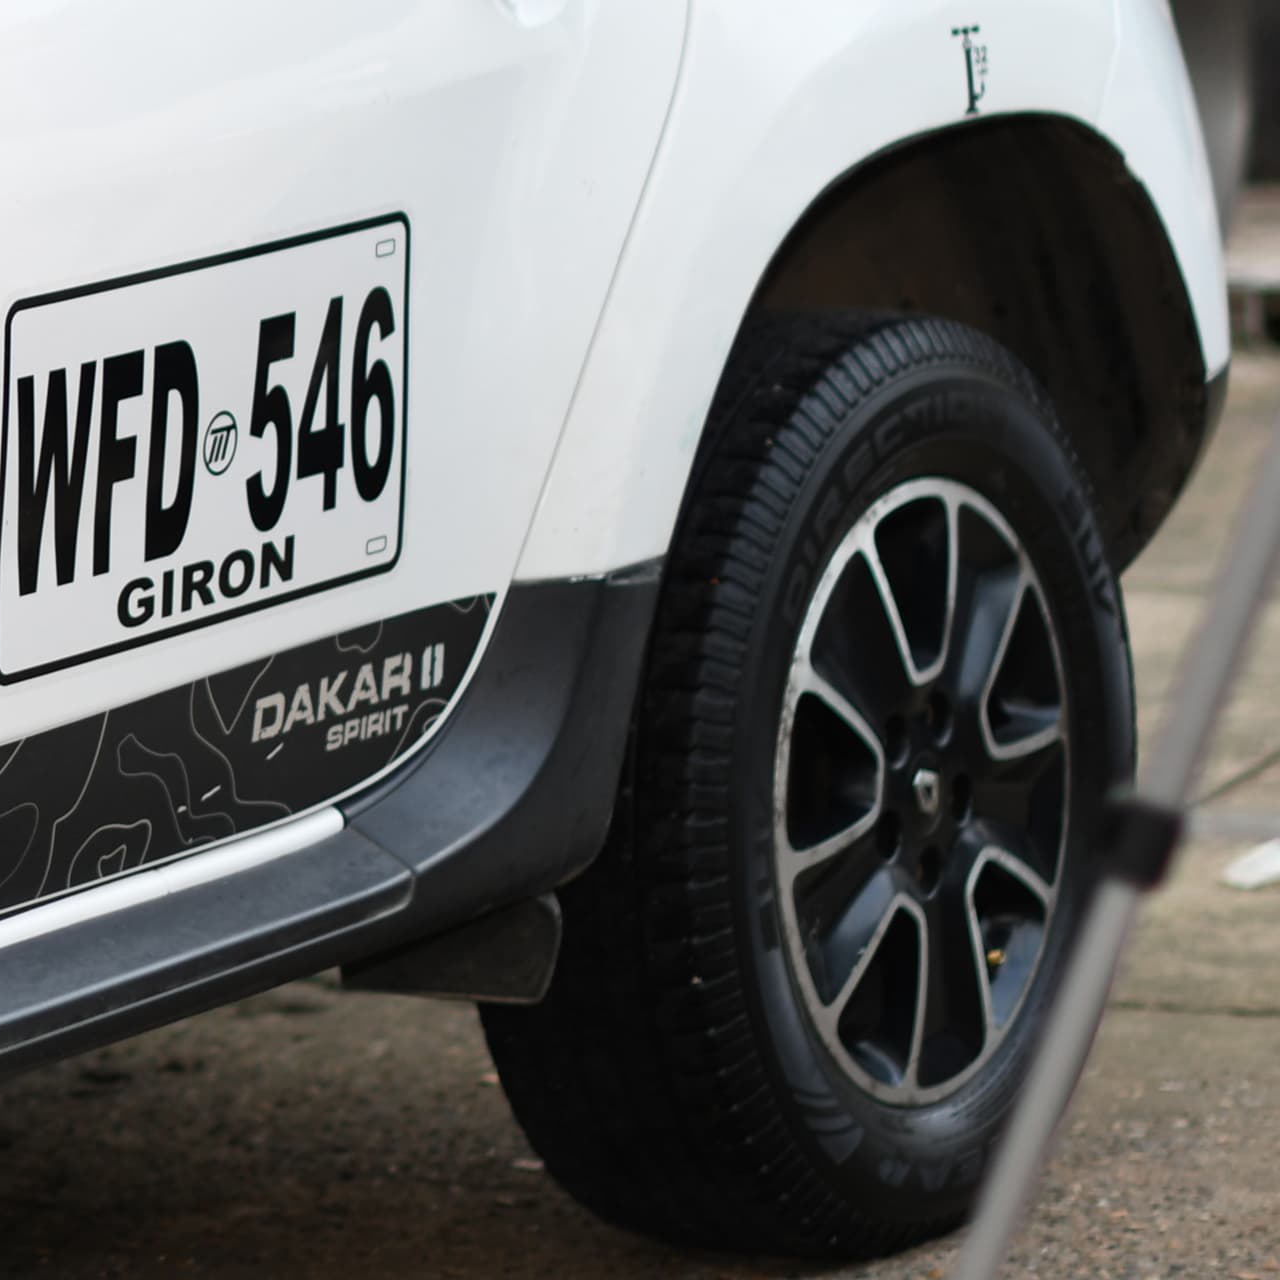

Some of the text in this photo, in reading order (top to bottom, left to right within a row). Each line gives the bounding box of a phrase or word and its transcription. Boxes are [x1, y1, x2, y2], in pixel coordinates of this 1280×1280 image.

[17, 285, 396, 597] WFD 546
[117, 534, 296, 629] GIRON
[251, 651, 414, 744] DAKAR
[325, 703, 410, 752] SPIRIT
